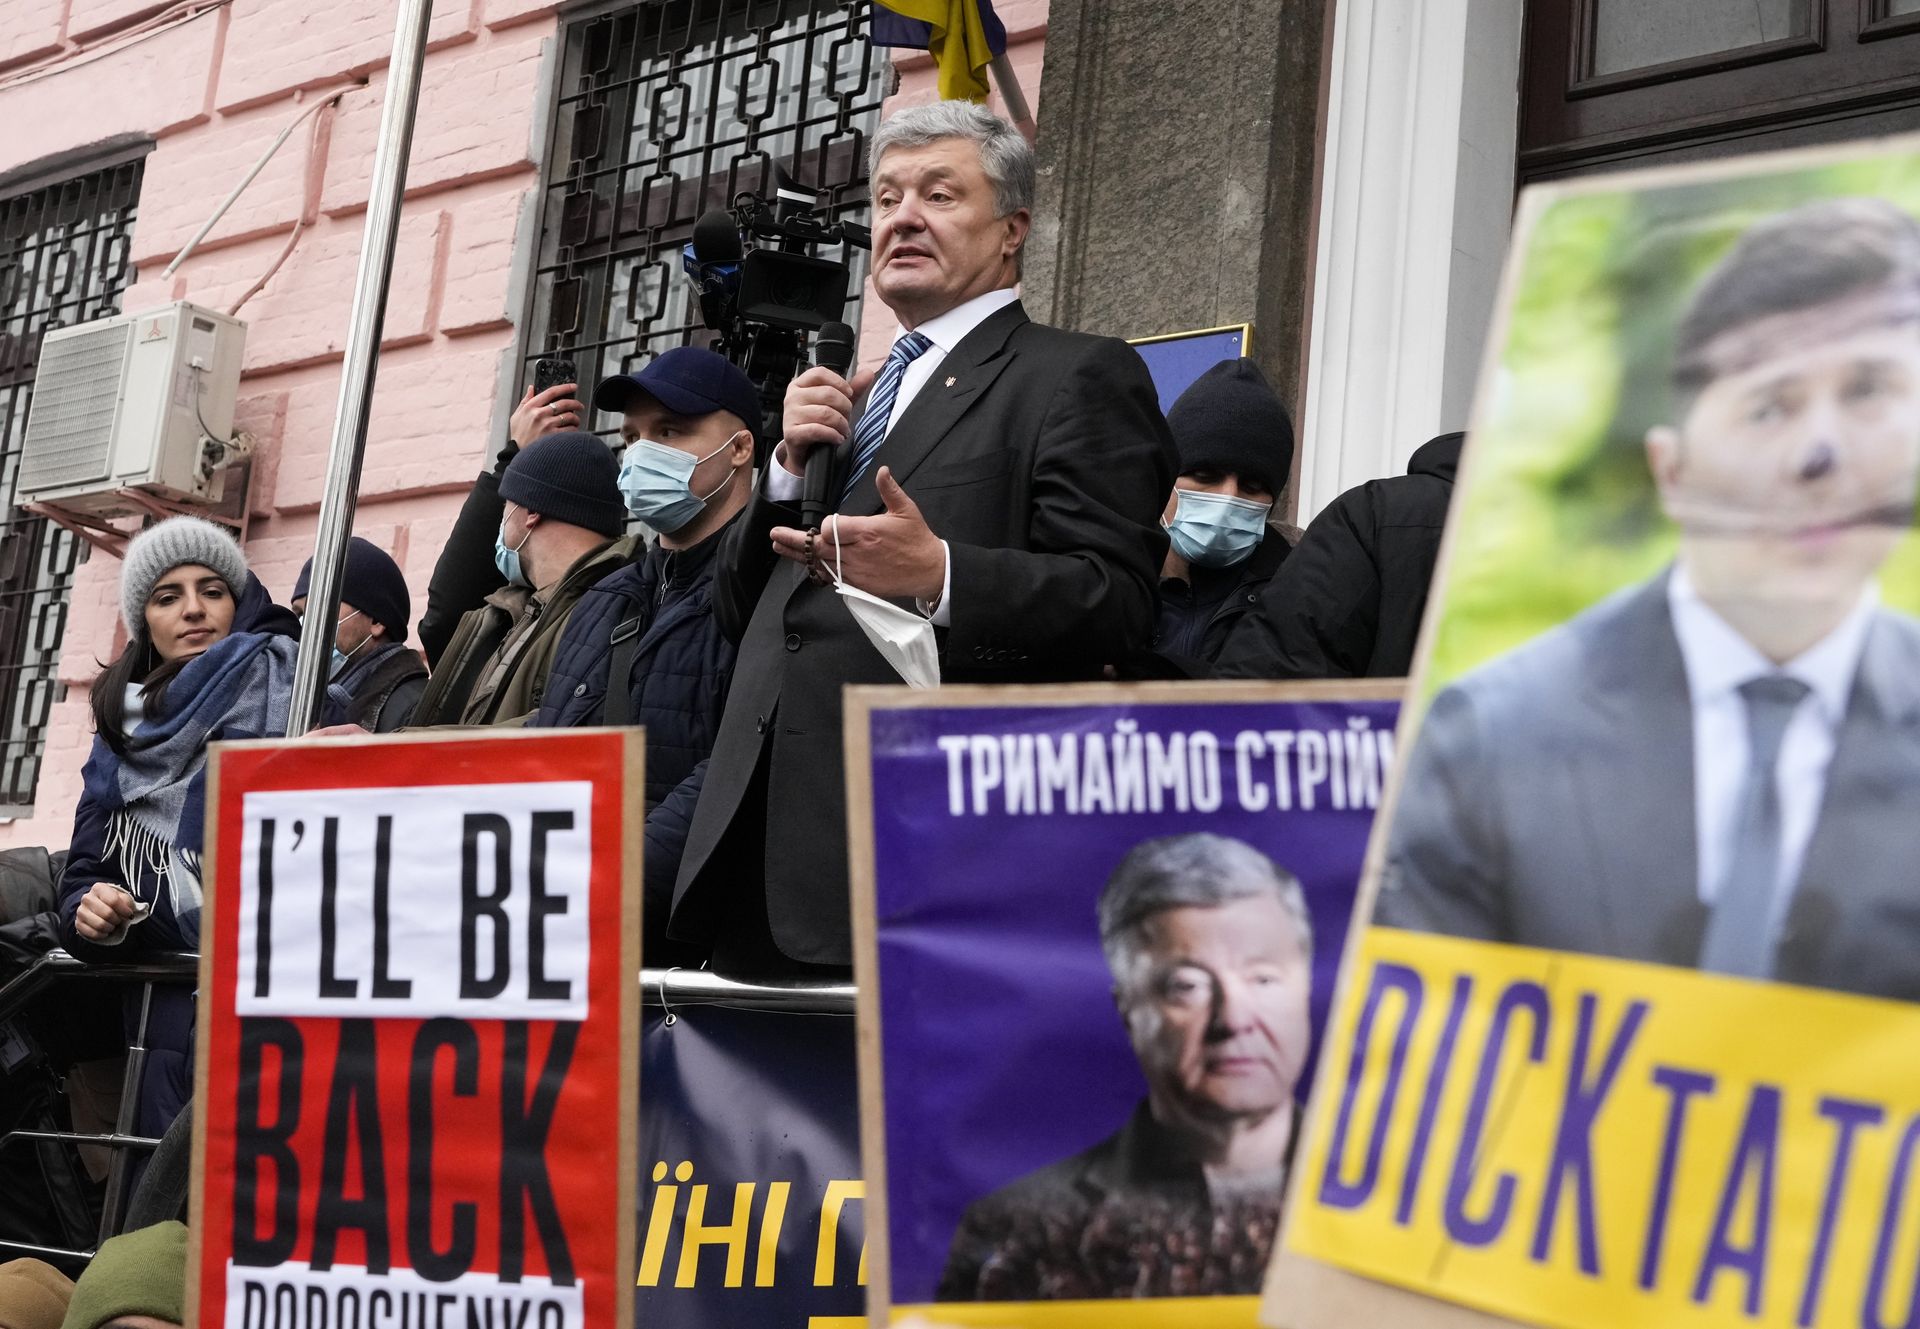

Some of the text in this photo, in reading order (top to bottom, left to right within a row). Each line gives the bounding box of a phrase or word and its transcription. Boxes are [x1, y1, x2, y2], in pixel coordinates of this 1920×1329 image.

[937, 718, 1222, 815] ТРИМАЙМО
[254, 811, 575, 1000] I'LL BE
[231, 1016, 584, 1288] BACK
